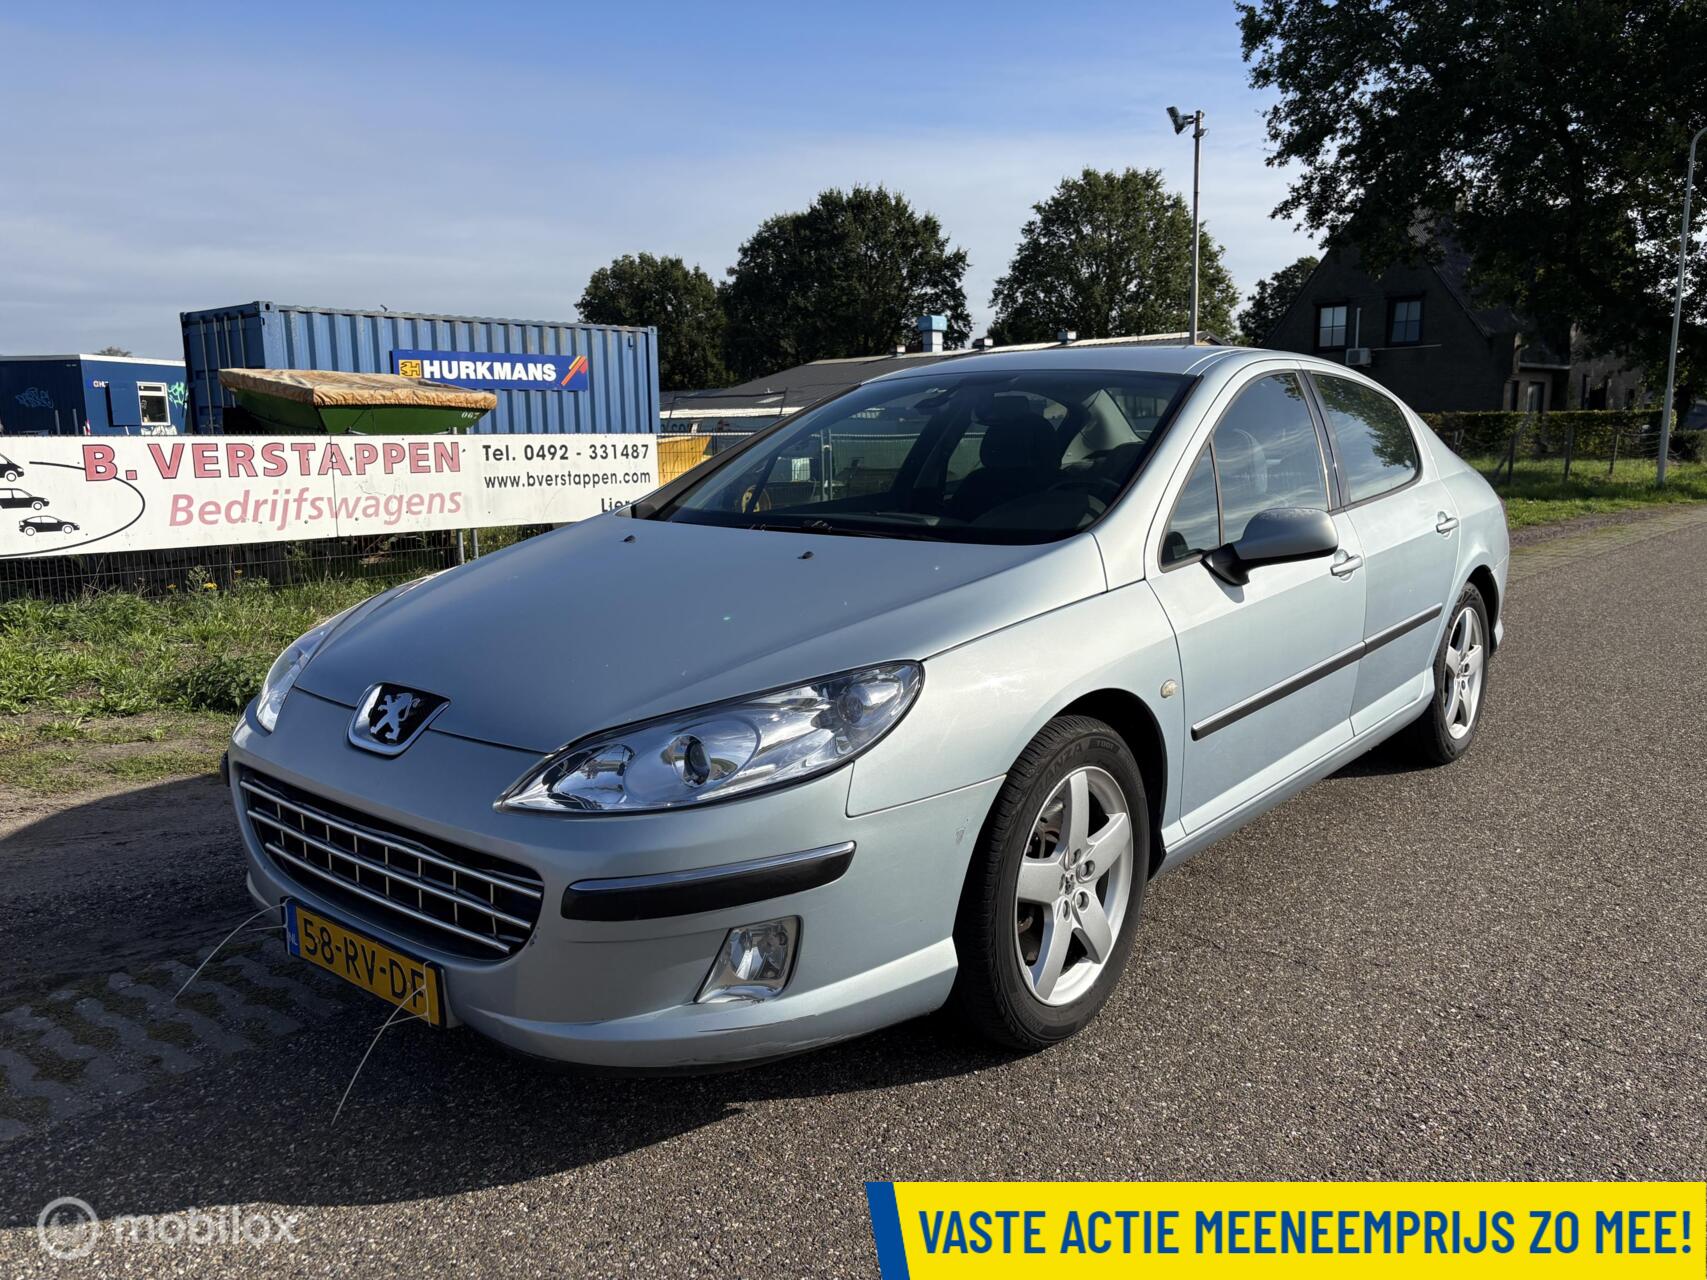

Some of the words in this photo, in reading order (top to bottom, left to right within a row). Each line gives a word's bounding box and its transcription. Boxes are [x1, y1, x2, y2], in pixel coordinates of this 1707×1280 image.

[423, 360, 557, 382] HURKMANS
[82, 443, 137, 482] B.
[148, 441, 461, 480] VERSTAPPEN
[482, 444, 517, 461] Tel.
[525, 444, 569, 460] 0492
[590, 443, 649, 460] 331487
[484, 470, 651, 488] www.bverstappen.com
[170, 487, 462, 531] Bedrijfswagens
[303, 917, 424, 1008] 58-RV-DF
